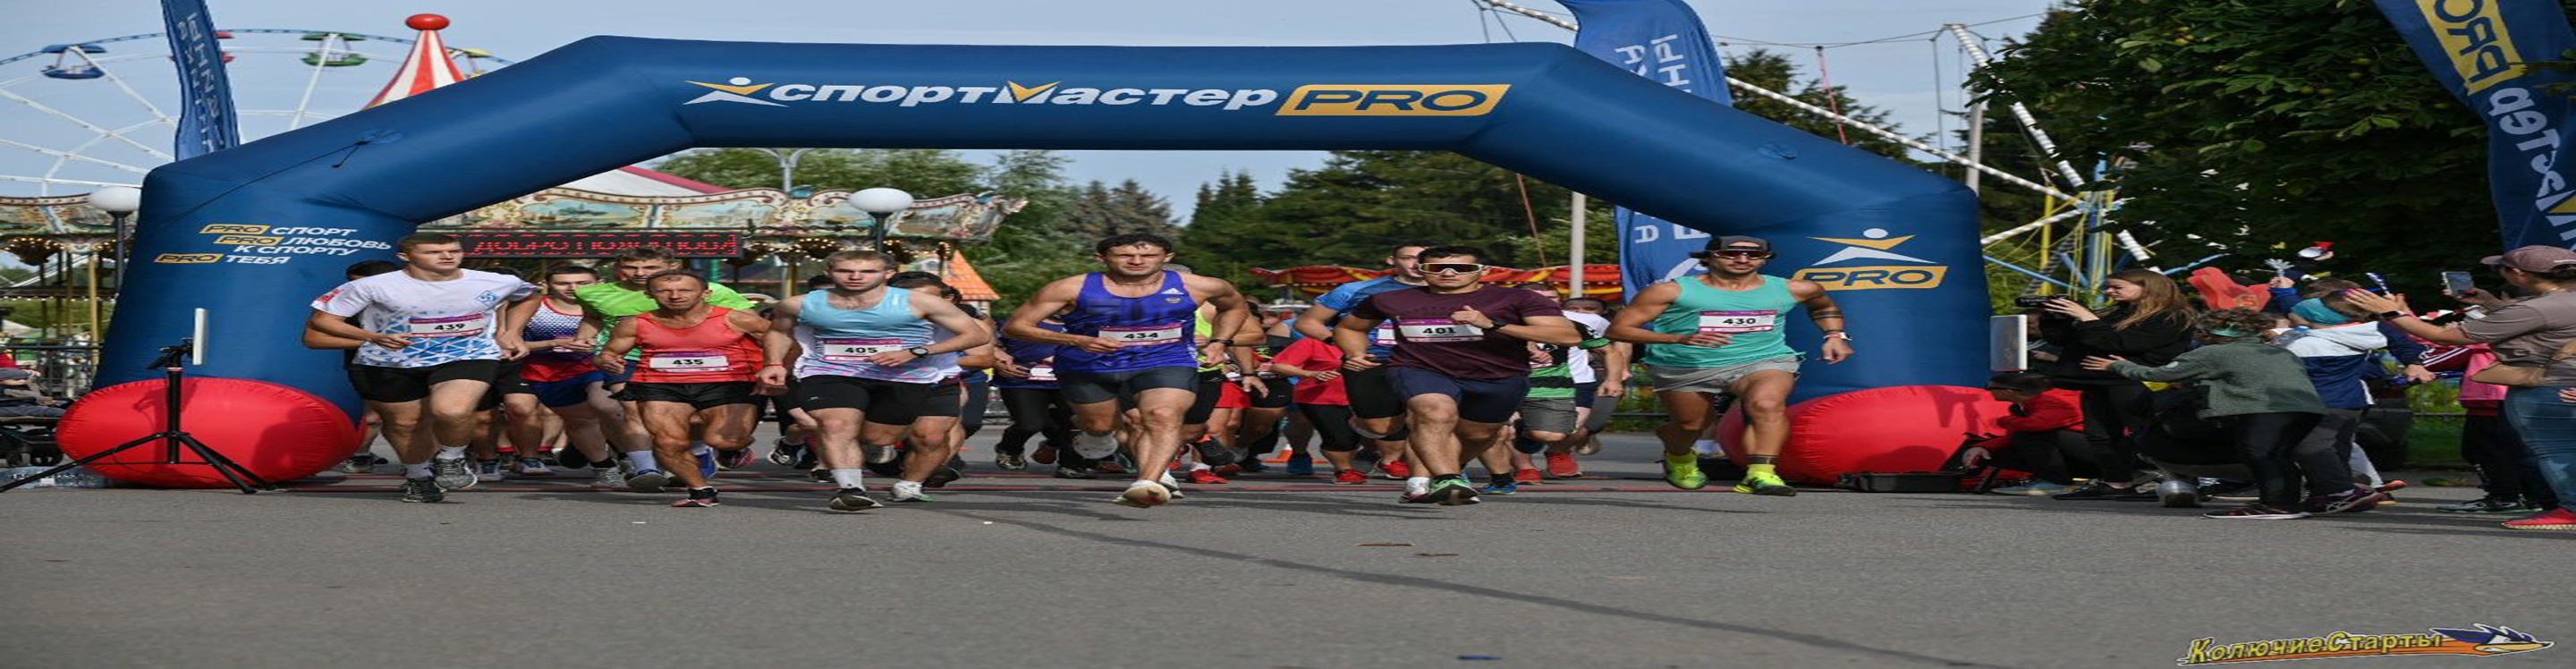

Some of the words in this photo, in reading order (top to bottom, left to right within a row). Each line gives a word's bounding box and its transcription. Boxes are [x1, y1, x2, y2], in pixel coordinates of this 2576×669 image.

[1293, 89, 1487, 112] PRO
[205, 224, 264, 233] PRO
[270, 226, 359, 236] СПОРТ
[219, 236, 279, 245] PRO
[282, 236, 392, 250] ЛЮБОВЬ
[233, 245, 251, 253] К
[257, 246, 360, 256] СПОРТУ
[159, 254, 217, 262] PRO
[225, 254, 292, 265] ТЕБЯ
[1802, 269, 1934, 287] PRO
[434, 323, 466, 331] 439
[1422, 326, 1456, 334] 401
